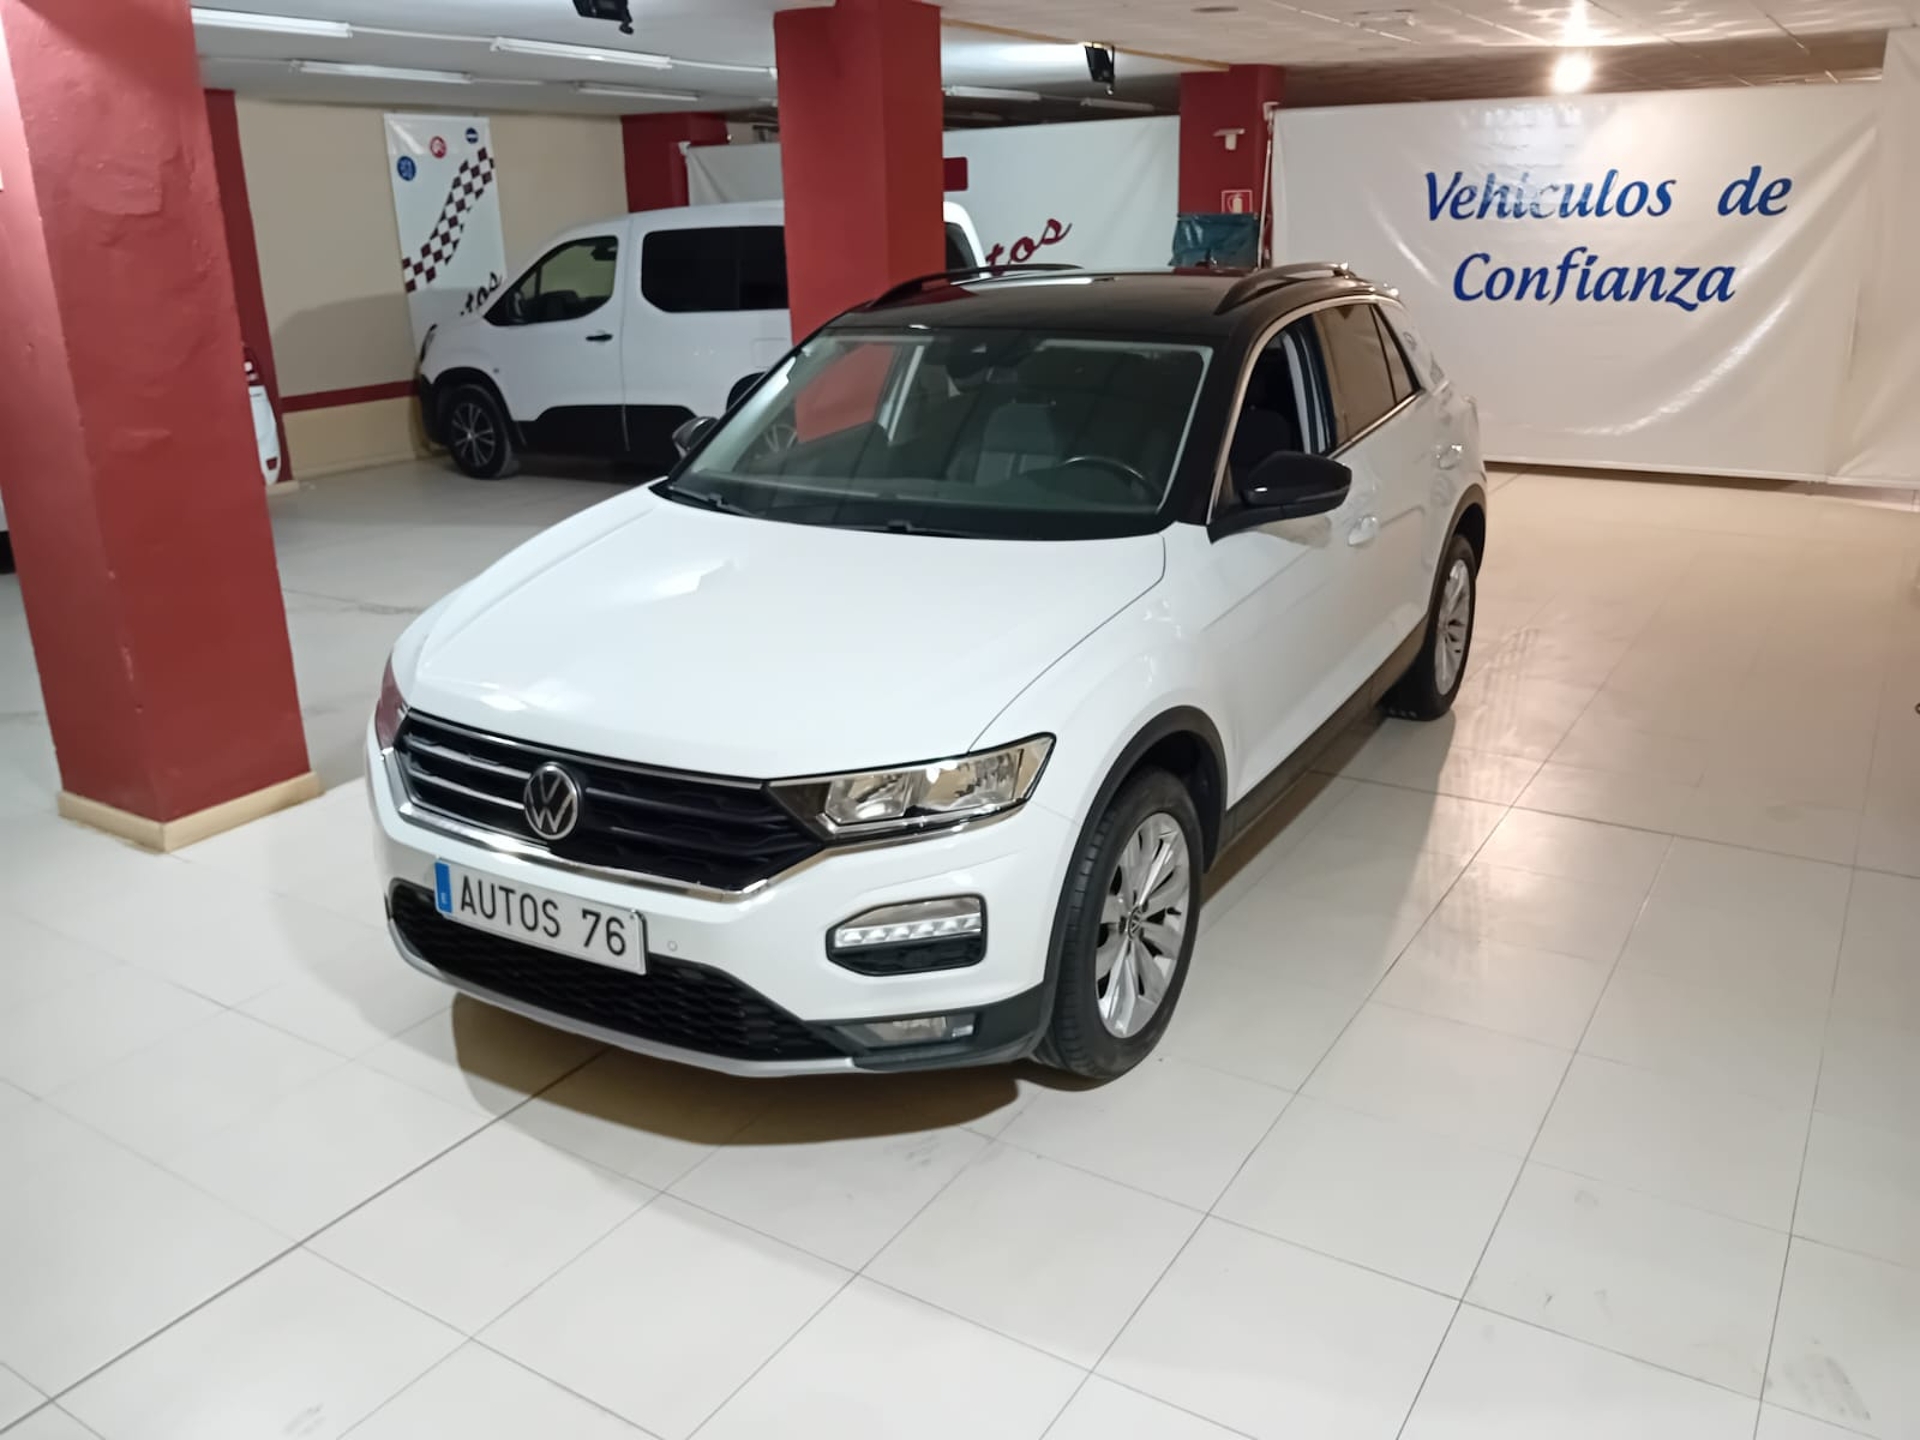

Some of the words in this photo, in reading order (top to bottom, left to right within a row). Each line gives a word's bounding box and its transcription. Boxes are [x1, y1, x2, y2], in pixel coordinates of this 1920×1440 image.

[1717, 165, 1793, 217] de
[1453, 246, 1736, 311] Confianza
[460, 874, 561, 938] AUTOS
[581, 908, 626, 956] 76
